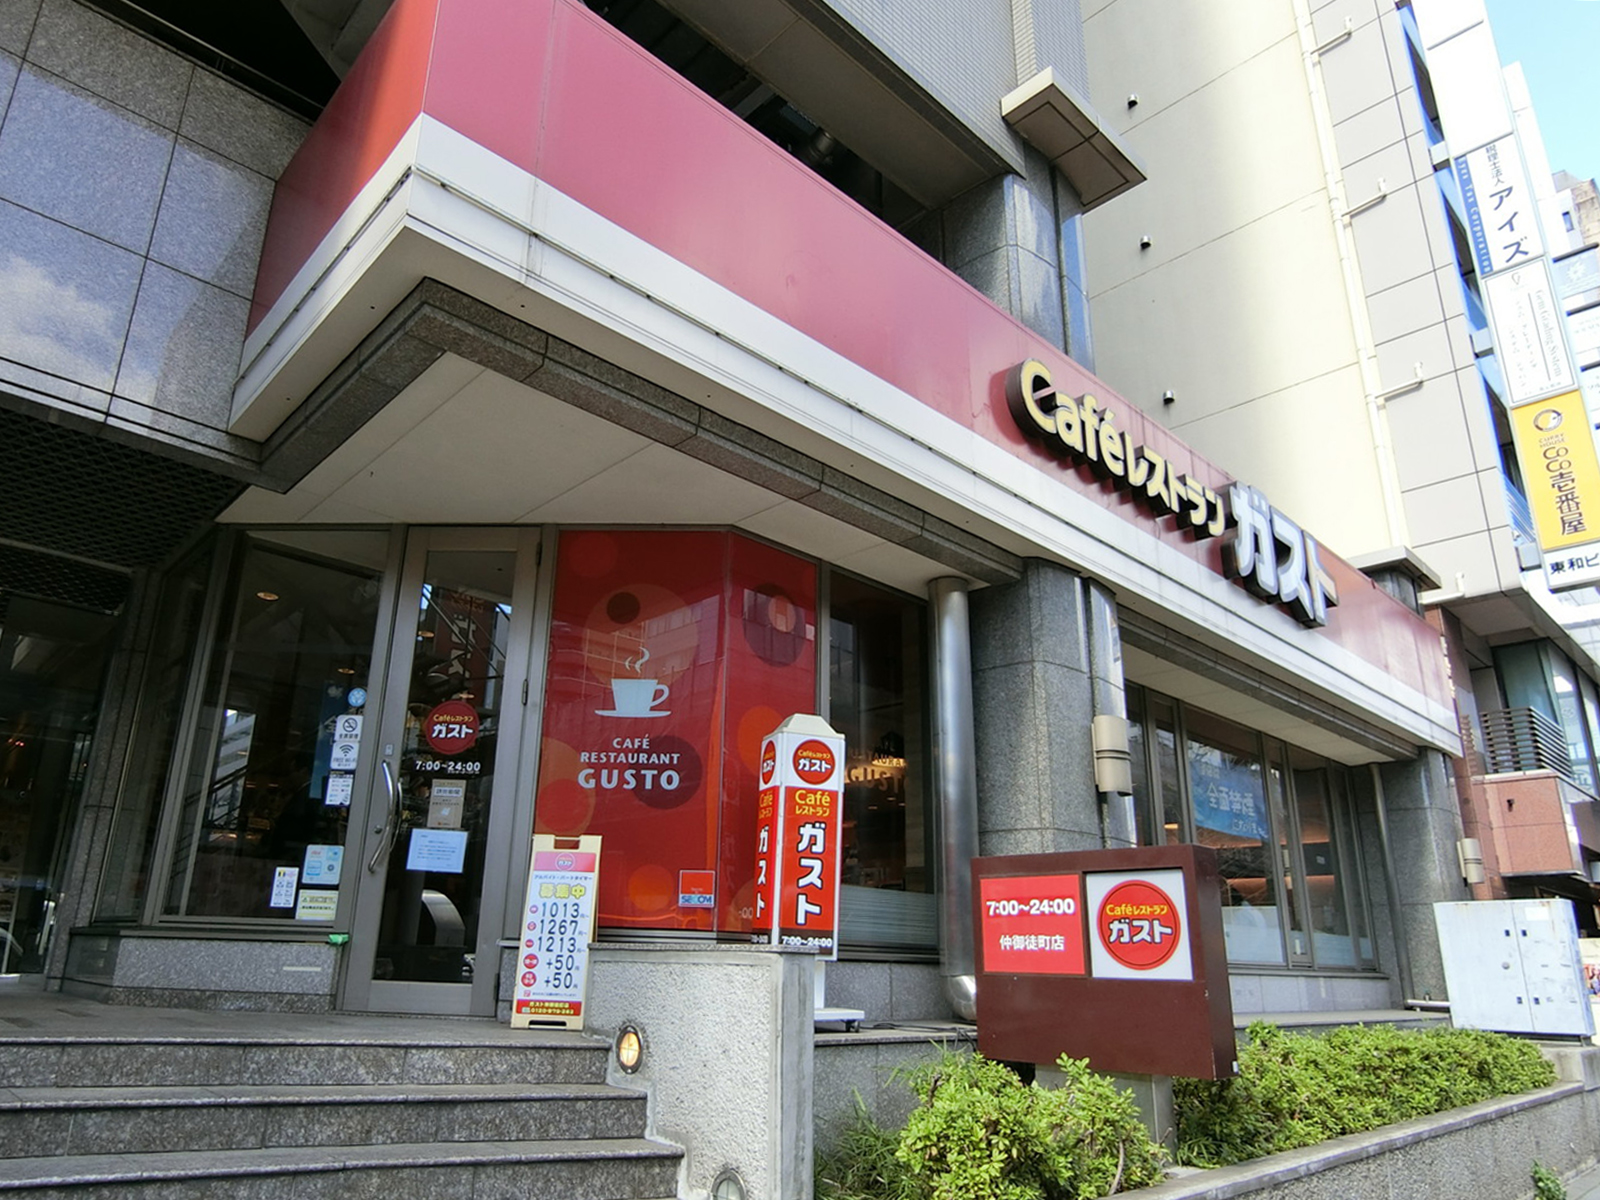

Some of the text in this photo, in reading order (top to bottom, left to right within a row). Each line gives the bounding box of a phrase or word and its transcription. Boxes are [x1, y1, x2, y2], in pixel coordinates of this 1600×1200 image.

[1488, 186, 1529, 264] アイズ
[1228, 480, 1340, 629] ガスト
[431, 723, 474, 739] ガスト
[612, 734, 650, 750] CAFÉ
[579, 751, 681, 766] RESTAURANT
[798, 758, 832, 773] ガスト
[577, 769, 681, 791] GUSTO
[795, 790, 831, 807] Café
[795, 805, 831, 818] レストラン
[756, 825, 770, 919] ガスト
[796, 821, 828, 926] ガスト
[1108, 917, 1174, 944] ガスト
[999, 934, 1065, 951] 仲御徒町店
